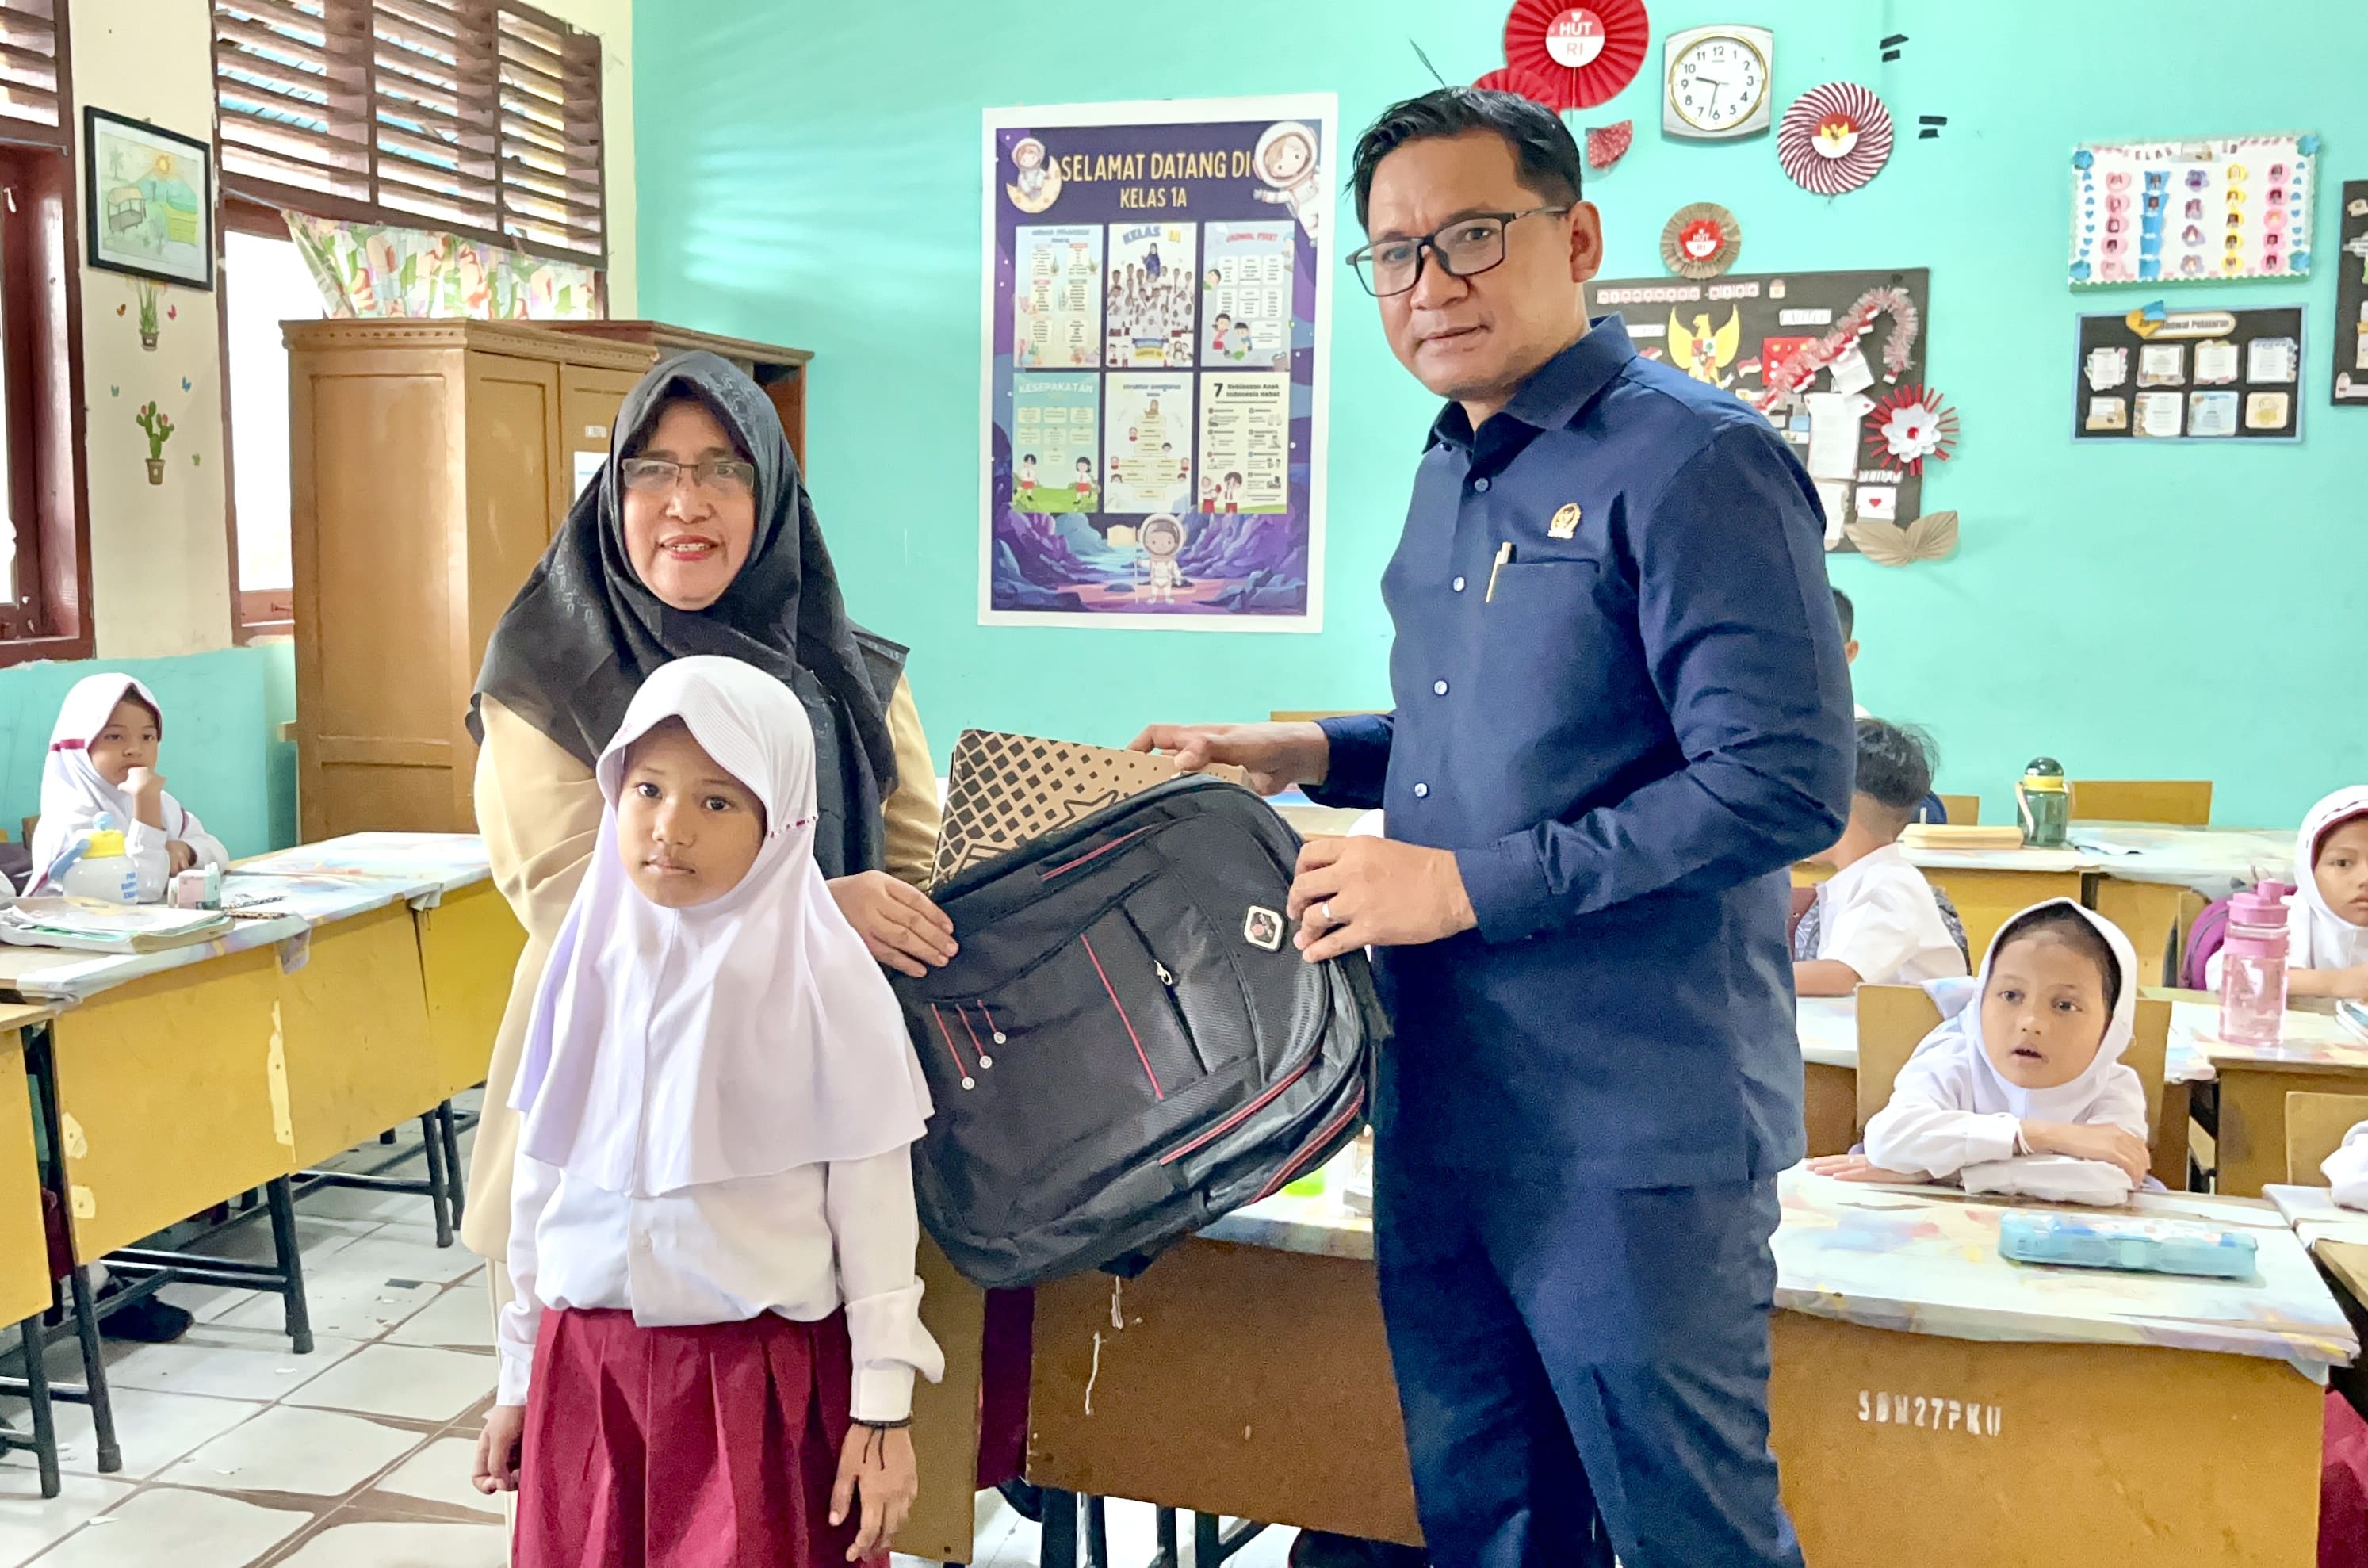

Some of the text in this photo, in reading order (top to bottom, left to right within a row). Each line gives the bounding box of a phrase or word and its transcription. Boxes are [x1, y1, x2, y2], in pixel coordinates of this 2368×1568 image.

[1559, 21, 1592, 36] HUT
[1566, 42, 1584, 55] RI
[1713, 46, 1724, 56] 12
[1697, 52, 1706, 61] 11
[1733, 50, 1737, 59] 1
[1684, 63, 1696, 74] 10
[1743, 60, 1750, 71] 2
[1681, 79, 1689, 90] 9
[1746, 75, 1754, 86] 3
[1685, 95, 1693, 106] 8
[1740, 91, 1748, 102] 4
[1698, 106, 1704, 117] 7
[1712, 109, 1720, 120] 6
[1730, 105, 1737, 115] 5
[1062, 151, 1250, 182] SELAMAT DATANG DI
[1120, 186, 1188, 208] KELAS 1A
[1122, 226, 1161, 245] KELAS
[1693, 233, 1710, 242] HUT
[1697, 243, 1706, 251] RI
[1018, 382, 1094, 394] KESEPAKATAN
[1213, 383, 1223, 398] 7
